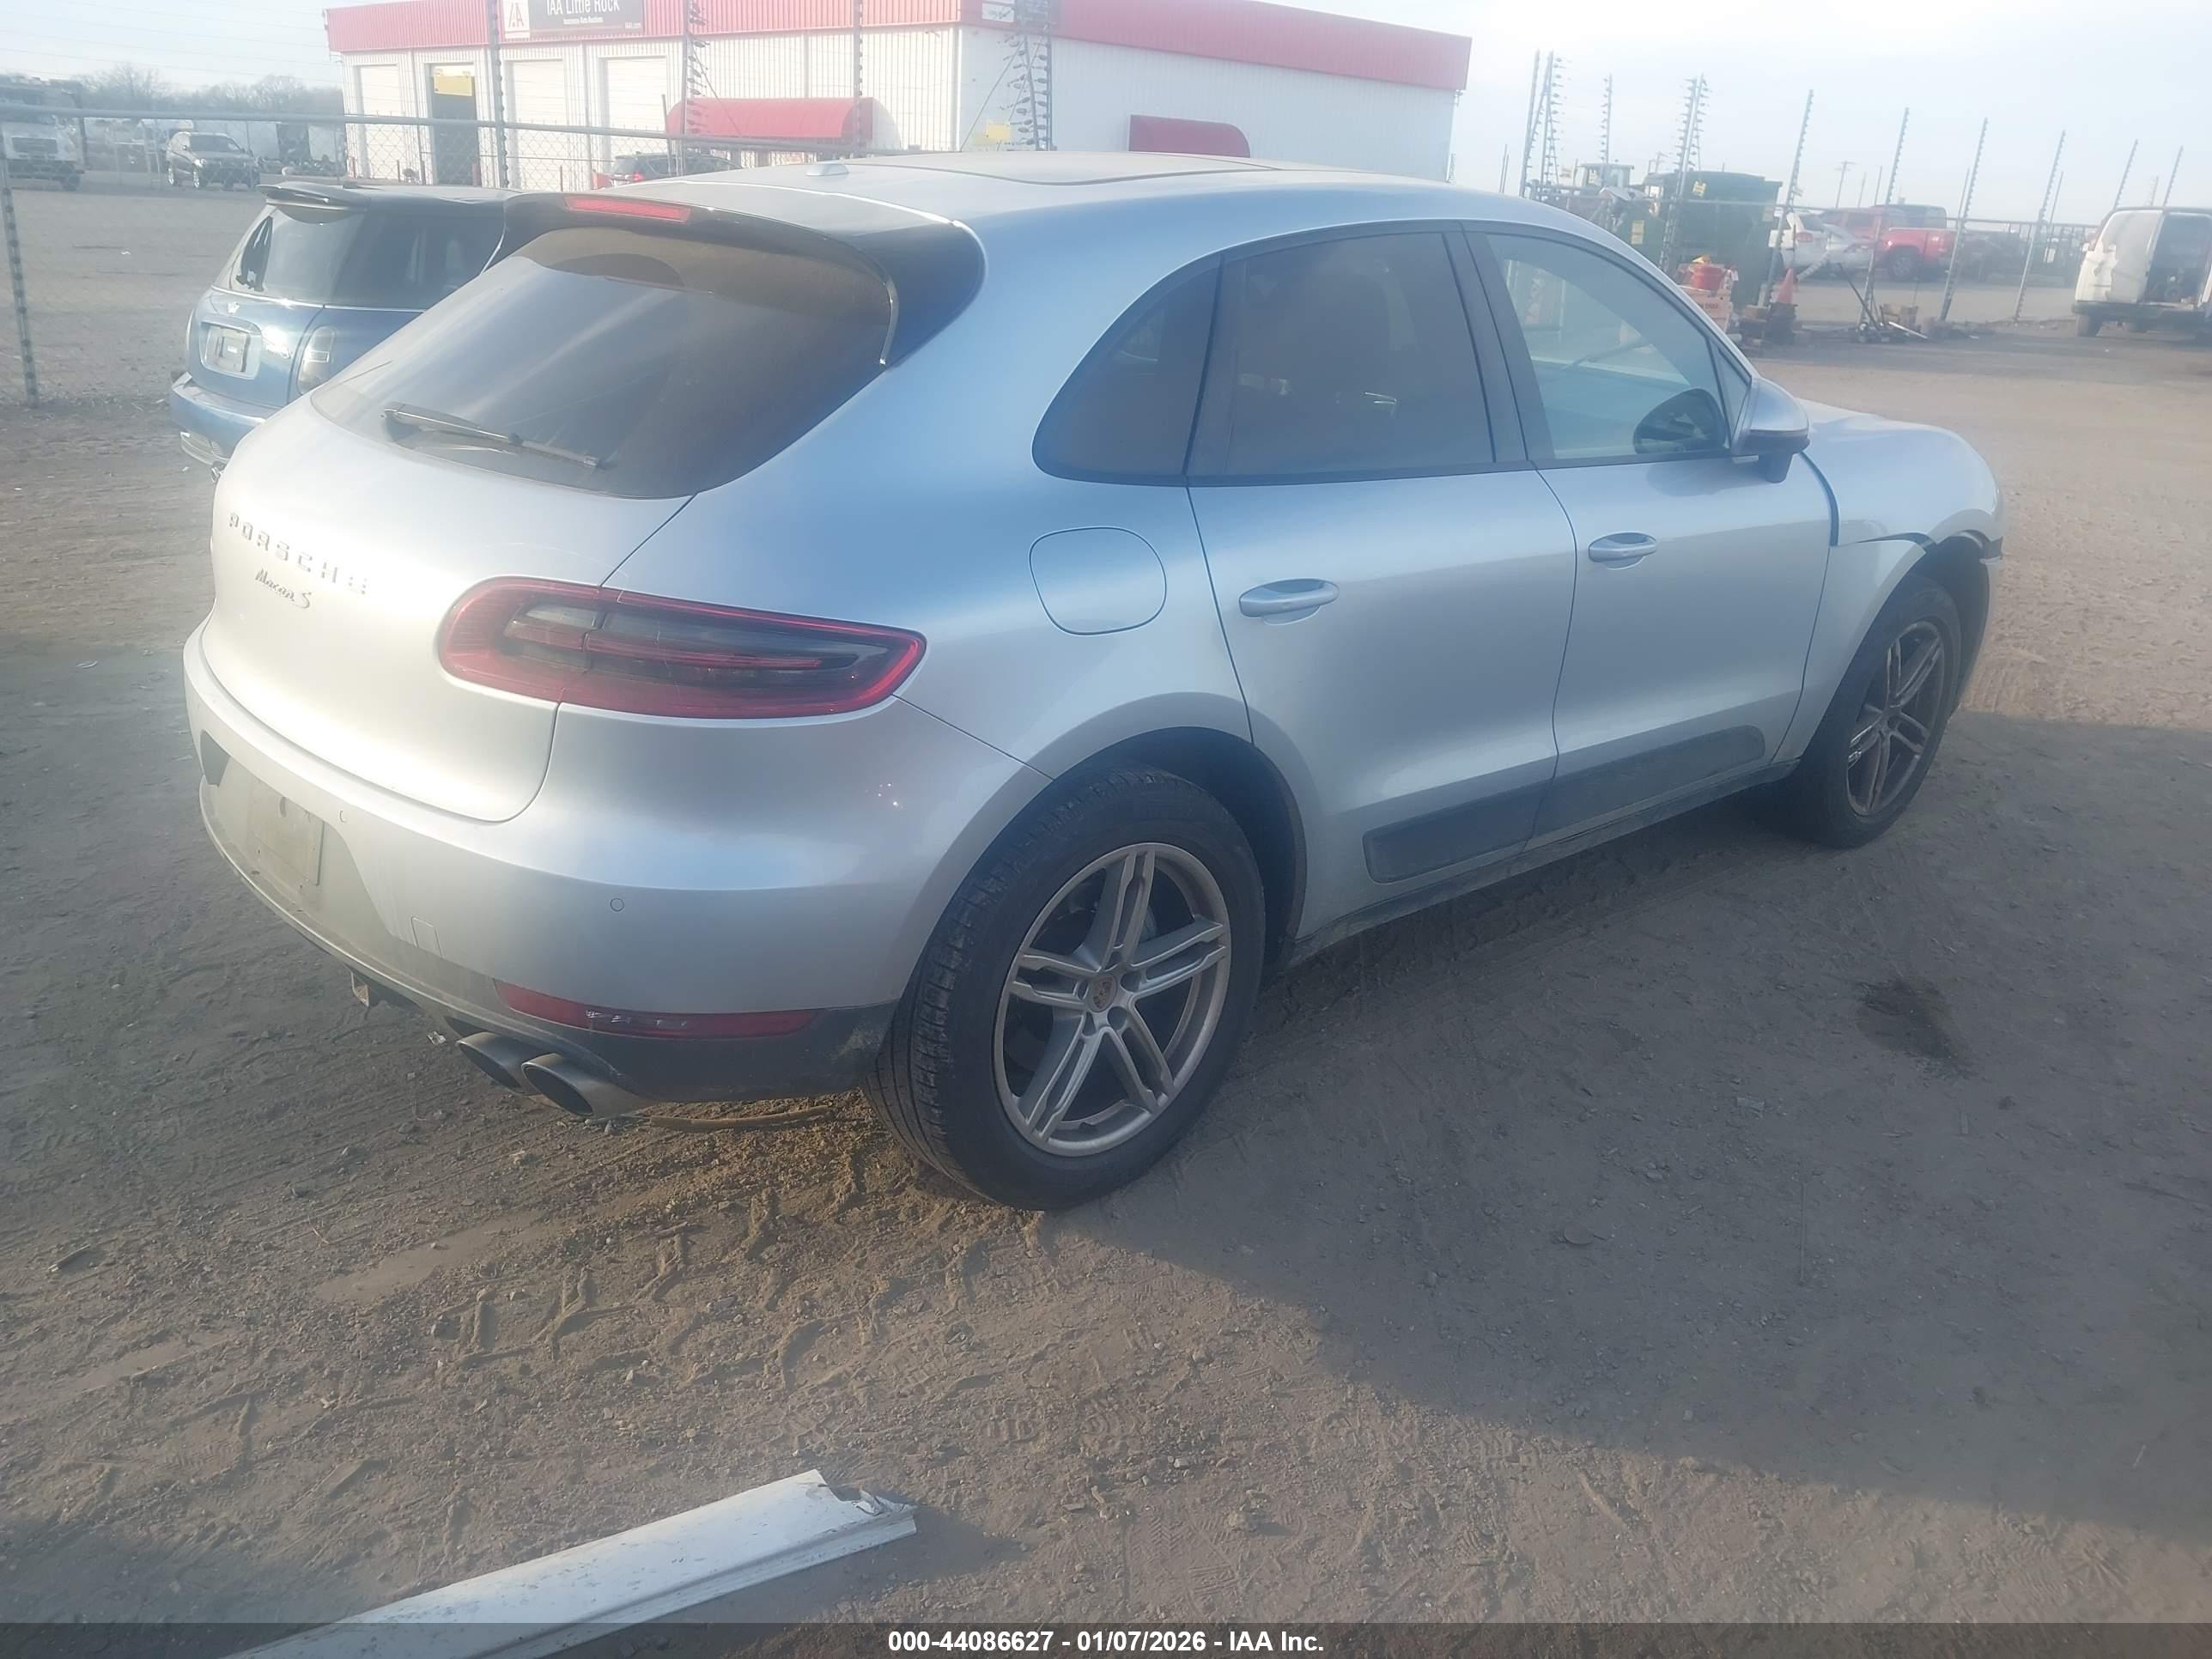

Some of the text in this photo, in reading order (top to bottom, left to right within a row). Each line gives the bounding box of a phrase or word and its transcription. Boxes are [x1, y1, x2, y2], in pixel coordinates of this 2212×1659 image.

[546, 0, 620, 15] IAA Little Rock
[254, 568, 313, 609] Macan S
